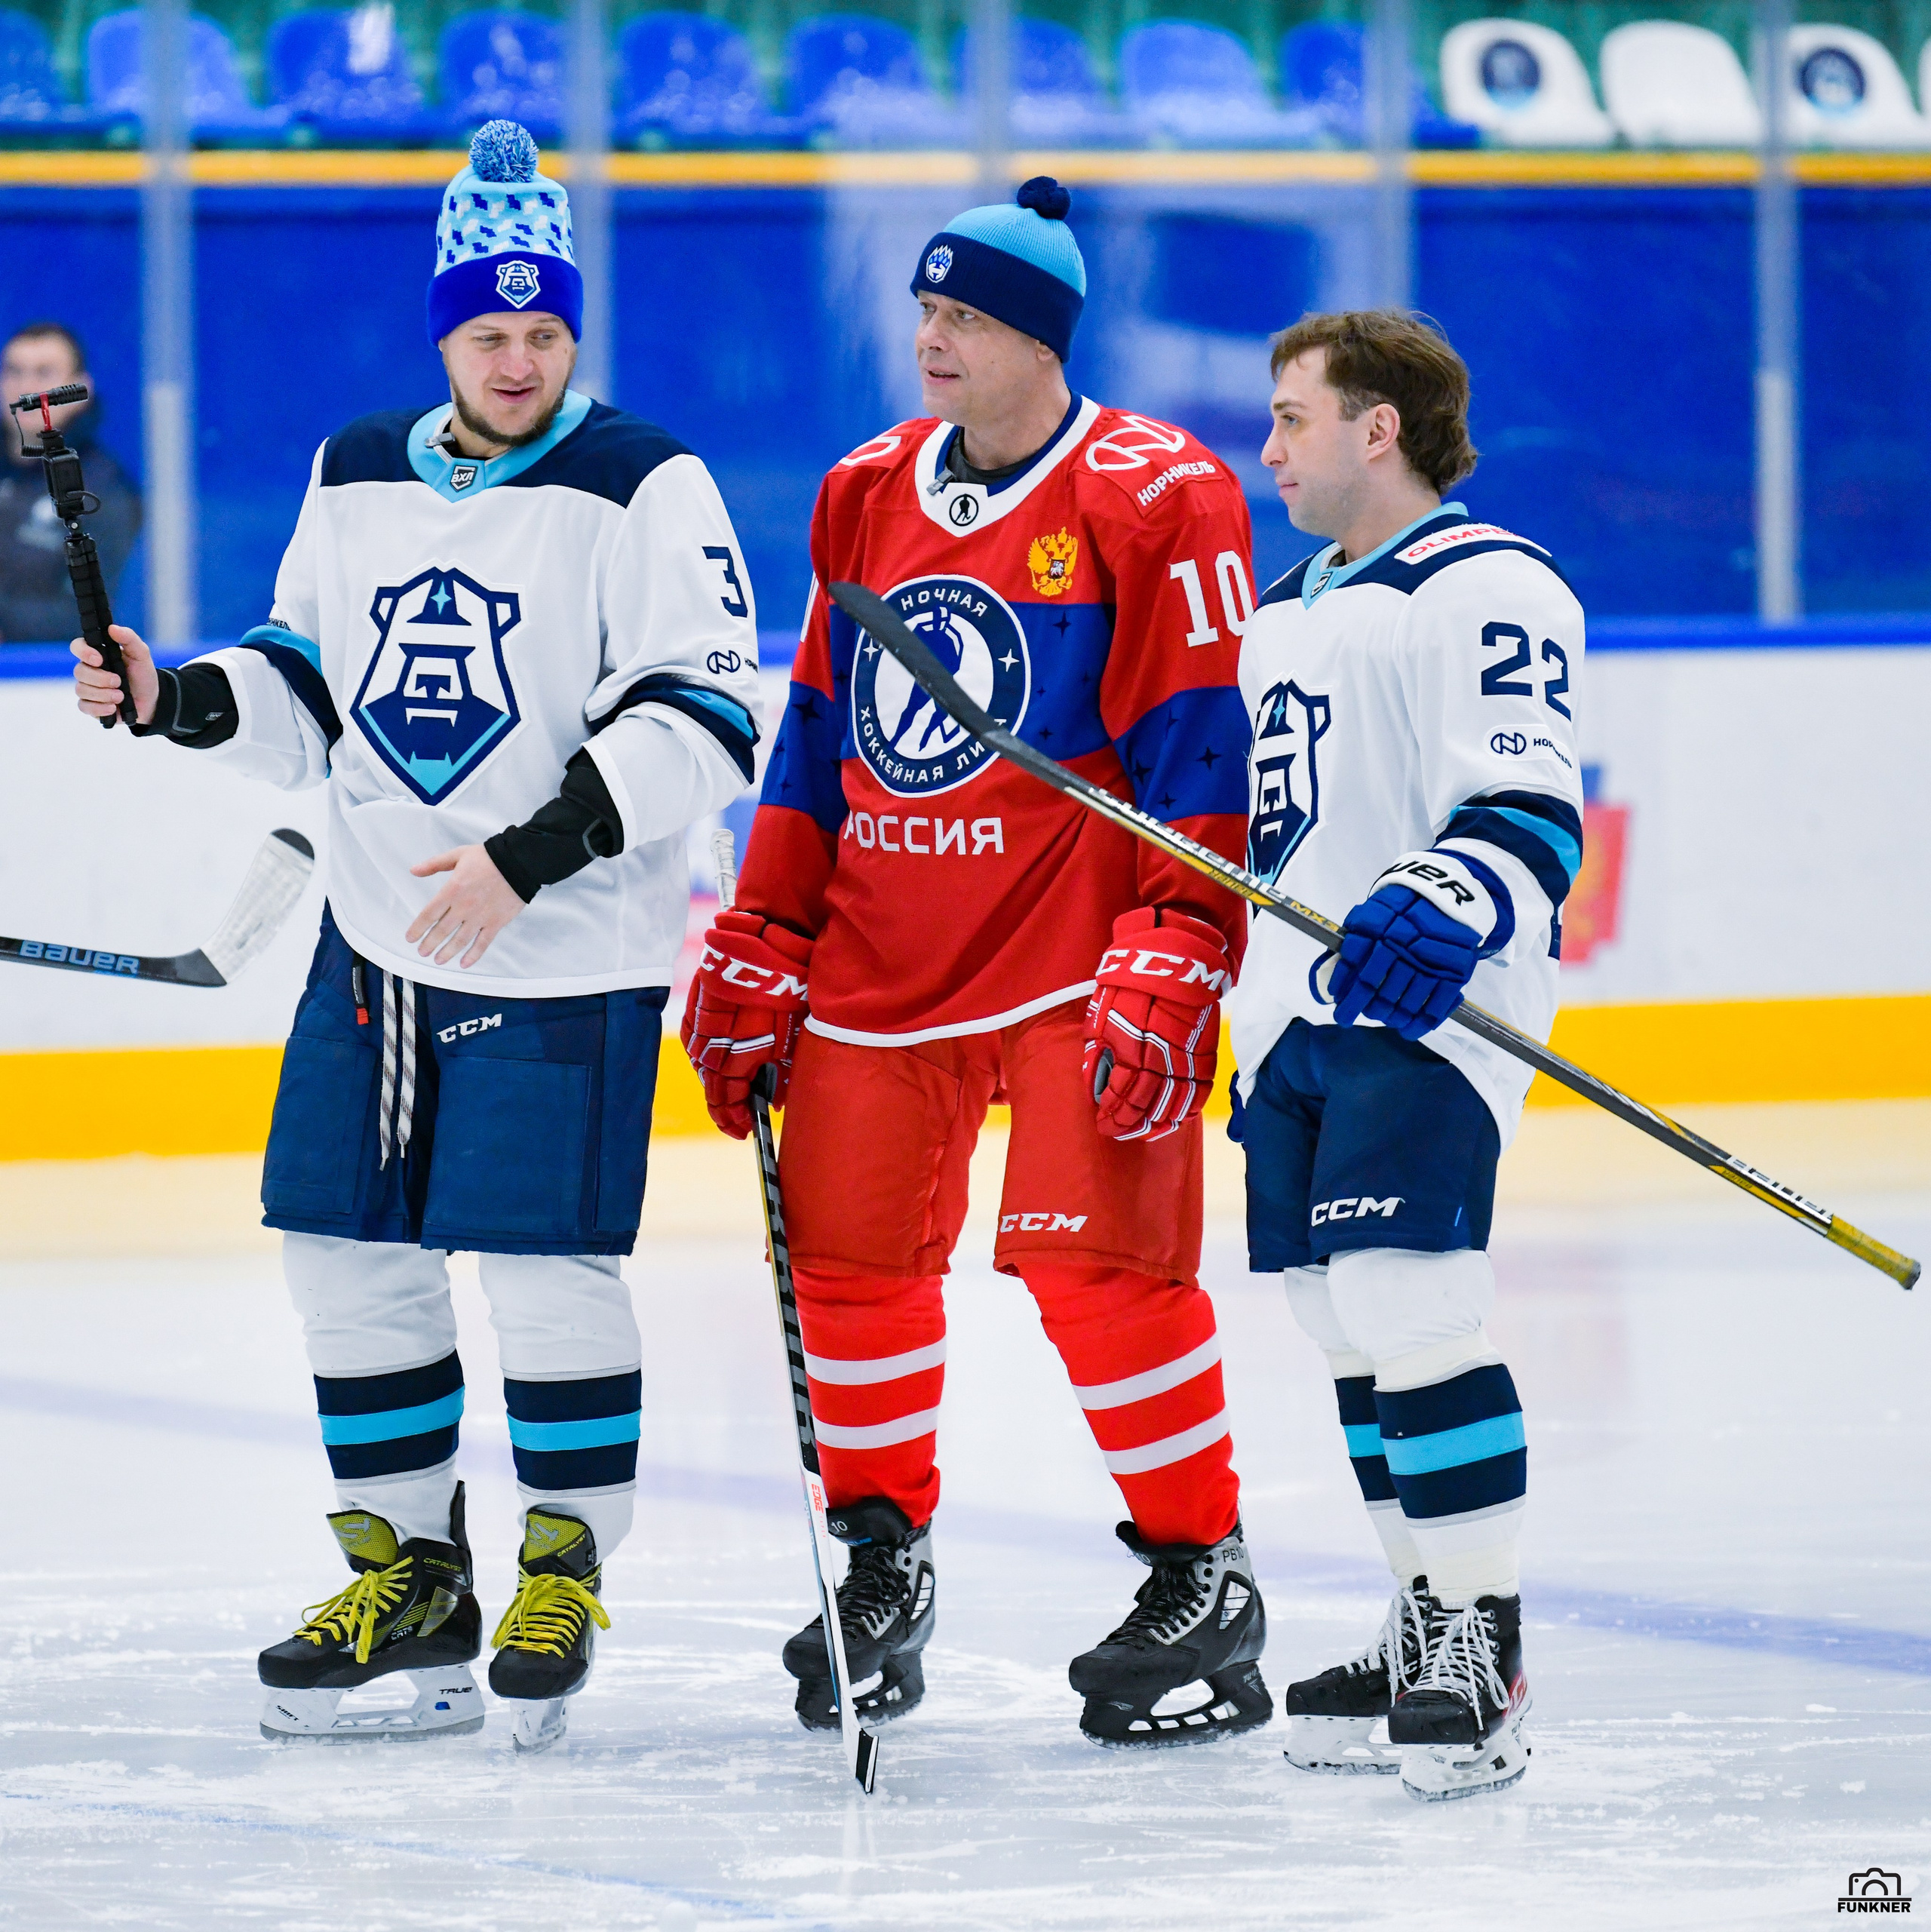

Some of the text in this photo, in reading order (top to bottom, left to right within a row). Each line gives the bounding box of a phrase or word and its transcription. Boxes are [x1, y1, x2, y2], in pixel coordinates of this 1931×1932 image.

[450, 471, 474, 483] ВХЛ
[1137, 461, 1216, 506] НОРНИКЕЛЬ
[701, 546, 748, 618] 3
[901, 588, 987, 616] НОЧНАЯ
[1170, 550, 1254, 647] 10
[1481, 621, 1571, 722] 22
[861, 706, 944, 782] ХОККЕЙНАЯ
[1289, 900, 1340, 932] MX3
[700, 942, 808, 1001] CCM
[1095, 949, 1226, 991] CCM
[436, 1013, 502, 1043] CCM
[1000, 1213, 1088, 1233] CCM
[1311, 1196, 1401, 1227] CCM
[811, 1483, 824, 1514] EDGE
[830, 1520, 849, 1532] 10
[423, 1558, 462, 1571] CATALYST
[439, 1686, 473, 1695] TRUE
